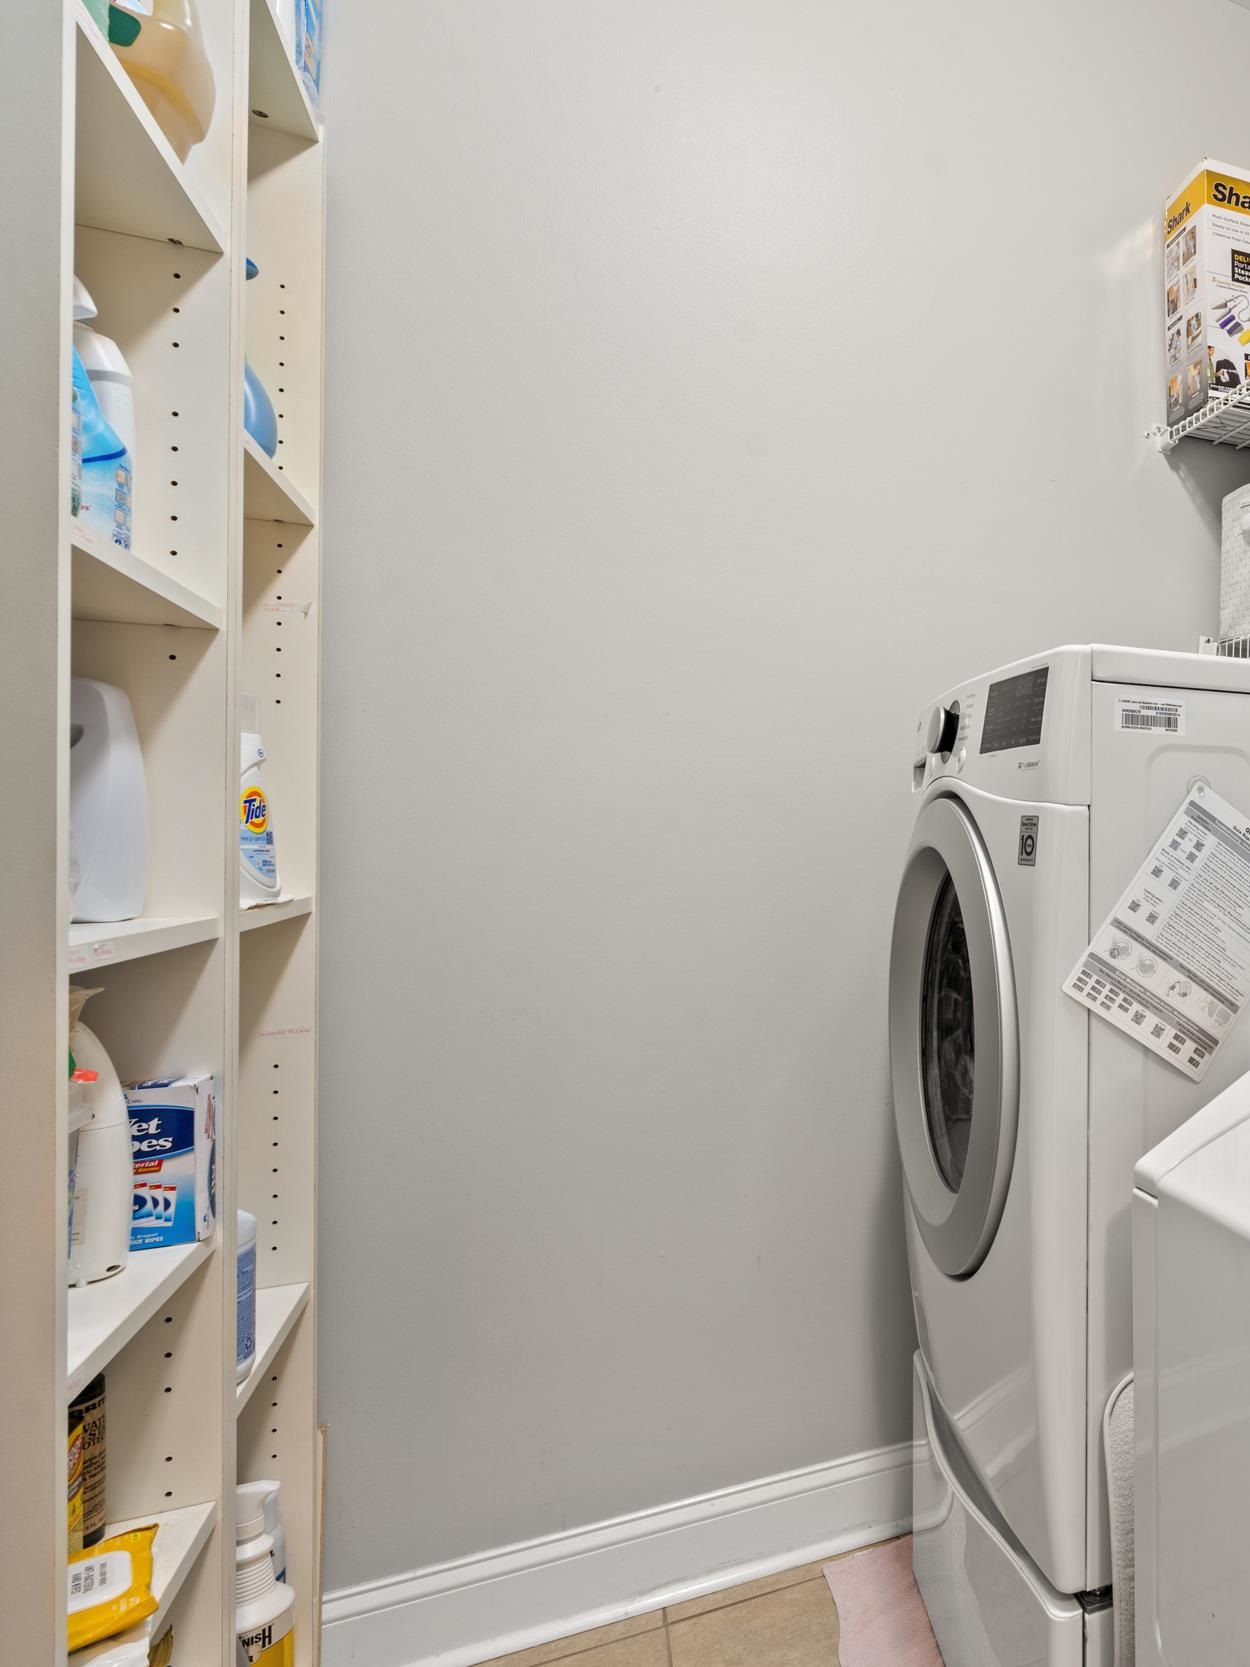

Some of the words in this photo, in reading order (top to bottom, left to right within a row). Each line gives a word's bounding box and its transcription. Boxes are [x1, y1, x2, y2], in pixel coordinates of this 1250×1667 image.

[1167, 201, 1191, 235] Shark
[243, 798, 266, 824] Tide
[1020, 834, 1035, 856] 10
[242, 1624, 273, 1649] NISH
